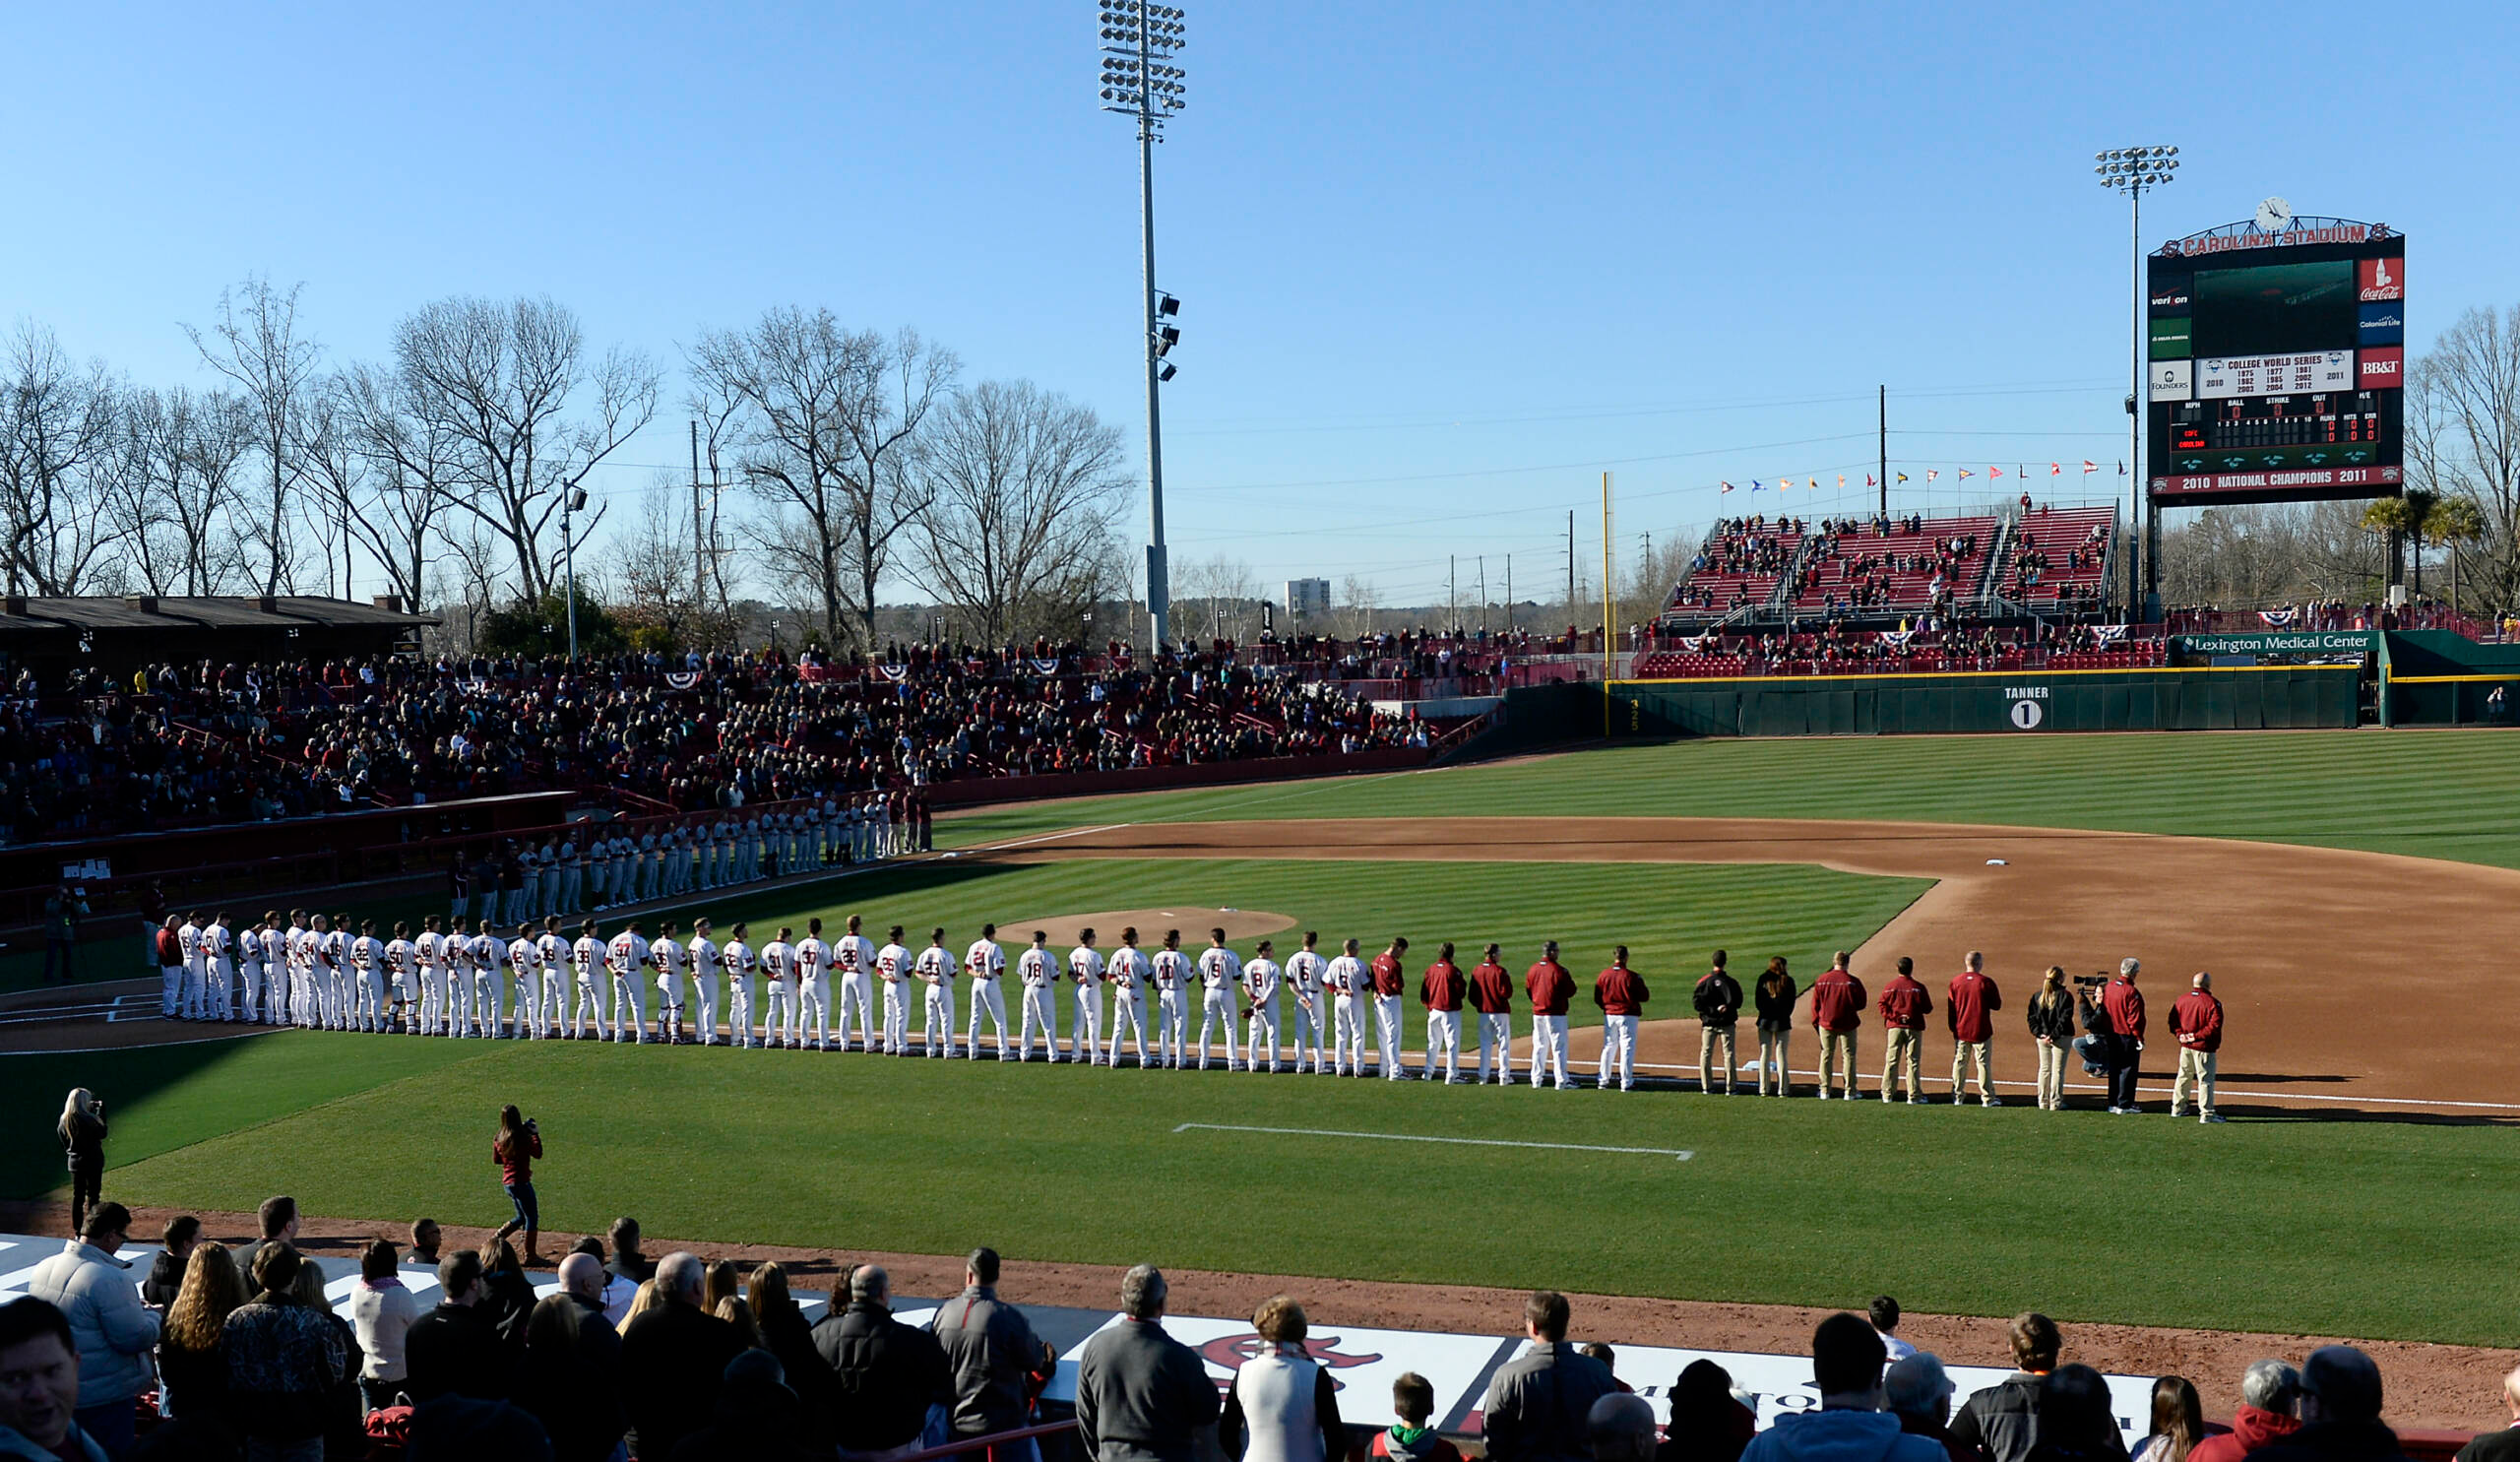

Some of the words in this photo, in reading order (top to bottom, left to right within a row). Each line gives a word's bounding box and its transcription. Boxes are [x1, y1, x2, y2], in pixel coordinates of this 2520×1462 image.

[2183, 233, 2273, 257] CAROLINA
[2283, 224, 2366, 246] STADIUM
[2152, 295, 2187, 306] verizon
[2228, 359, 2261, 369] COLLEGE
[2263, 357, 2292, 367] WORLD
[2294, 355, 2323, 366] SERIES
[2362, 360, 2399, 374] BB&T
[2232, 407, 2240, 418] 0
[2328, 421, 2336, 431] 0
[2350, 419, 2358, 430] 0
[2366, 418, 2374, 429] 0
[2328, 432, 2336, 442] 0
[2350, 430, 2358, 441] 0
[2366, 430, 2374, 440] 0
[2182, 477, 2210, 489] 2010
[2218, 475, 2266, 487] NATIONAL
[2270, 472, 2332, 485] CHAMPIONS
[2340, 470, 2366, 481] 2011
[2195, 638, 2261, 654] Lexington
[2265, 636, 2319, 650] Medical
[2323, 635, 2368, 648] Center
[2004, 686, 2049, 699] TANNER
[1630, 699, 1639, 731] 325
[2021, 704, 2030, 725] 1
[354, 948, 369, 962] 22
[389, 951, 403, 965] 50
[576, 950, 590, 964] 38
[768, 955, 782, 970] 31
[802, 950, 816, 966] 30
[842, 950, 857, 964] 28
[974, 951, 985, 967] 21
[924, 961, 940, 977] 23
[1027, 963, 1040, 979] 18
[1074, 962, 1085, 977] 17
[1116, 961, 1129, 977] 14
[1159, 965, 1173, 981] 10
[1299, 966, 1309, 982] 6
[1253, 973, 1262, 987] 8
